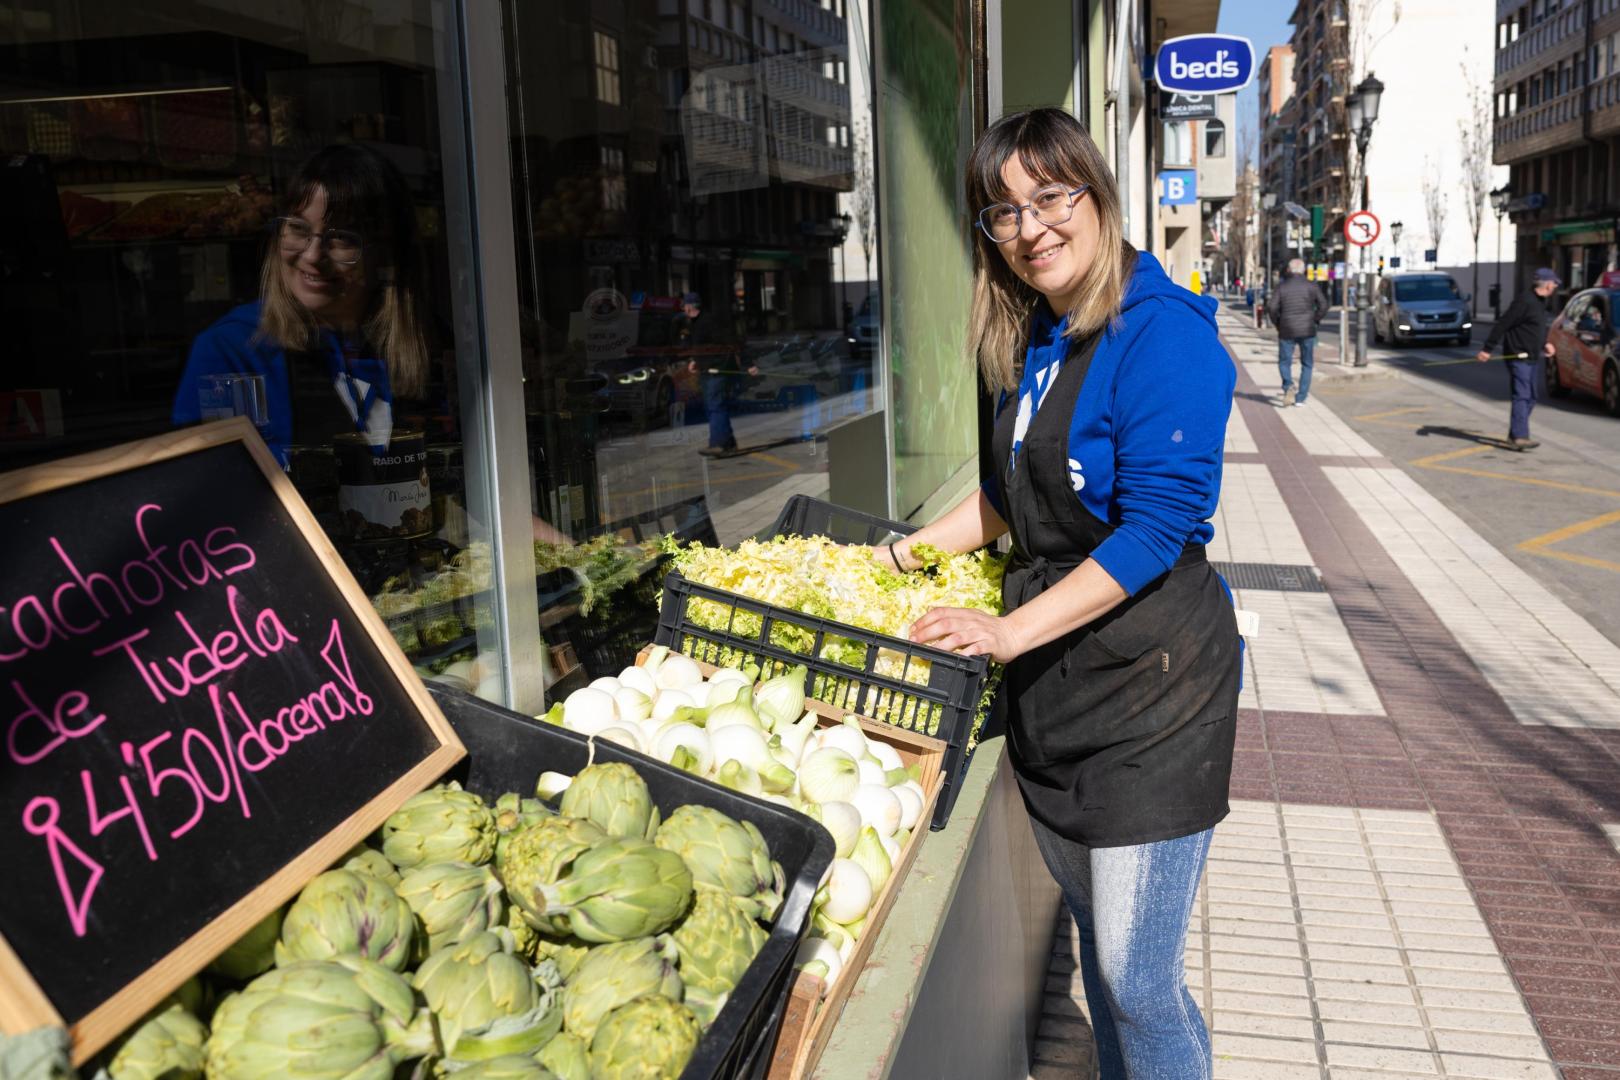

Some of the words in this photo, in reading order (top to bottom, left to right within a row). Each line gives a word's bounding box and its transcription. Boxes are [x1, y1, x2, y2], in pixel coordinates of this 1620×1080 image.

[1170, 50, 1240, 79] bed's
[1168, 177, 1185, 199] B
[373, 455, 402, 466] RABO
[404, 454, 416, 464] DE
[8, 679, 107, 765] de
[93, 584, 300, 703] Tudela
